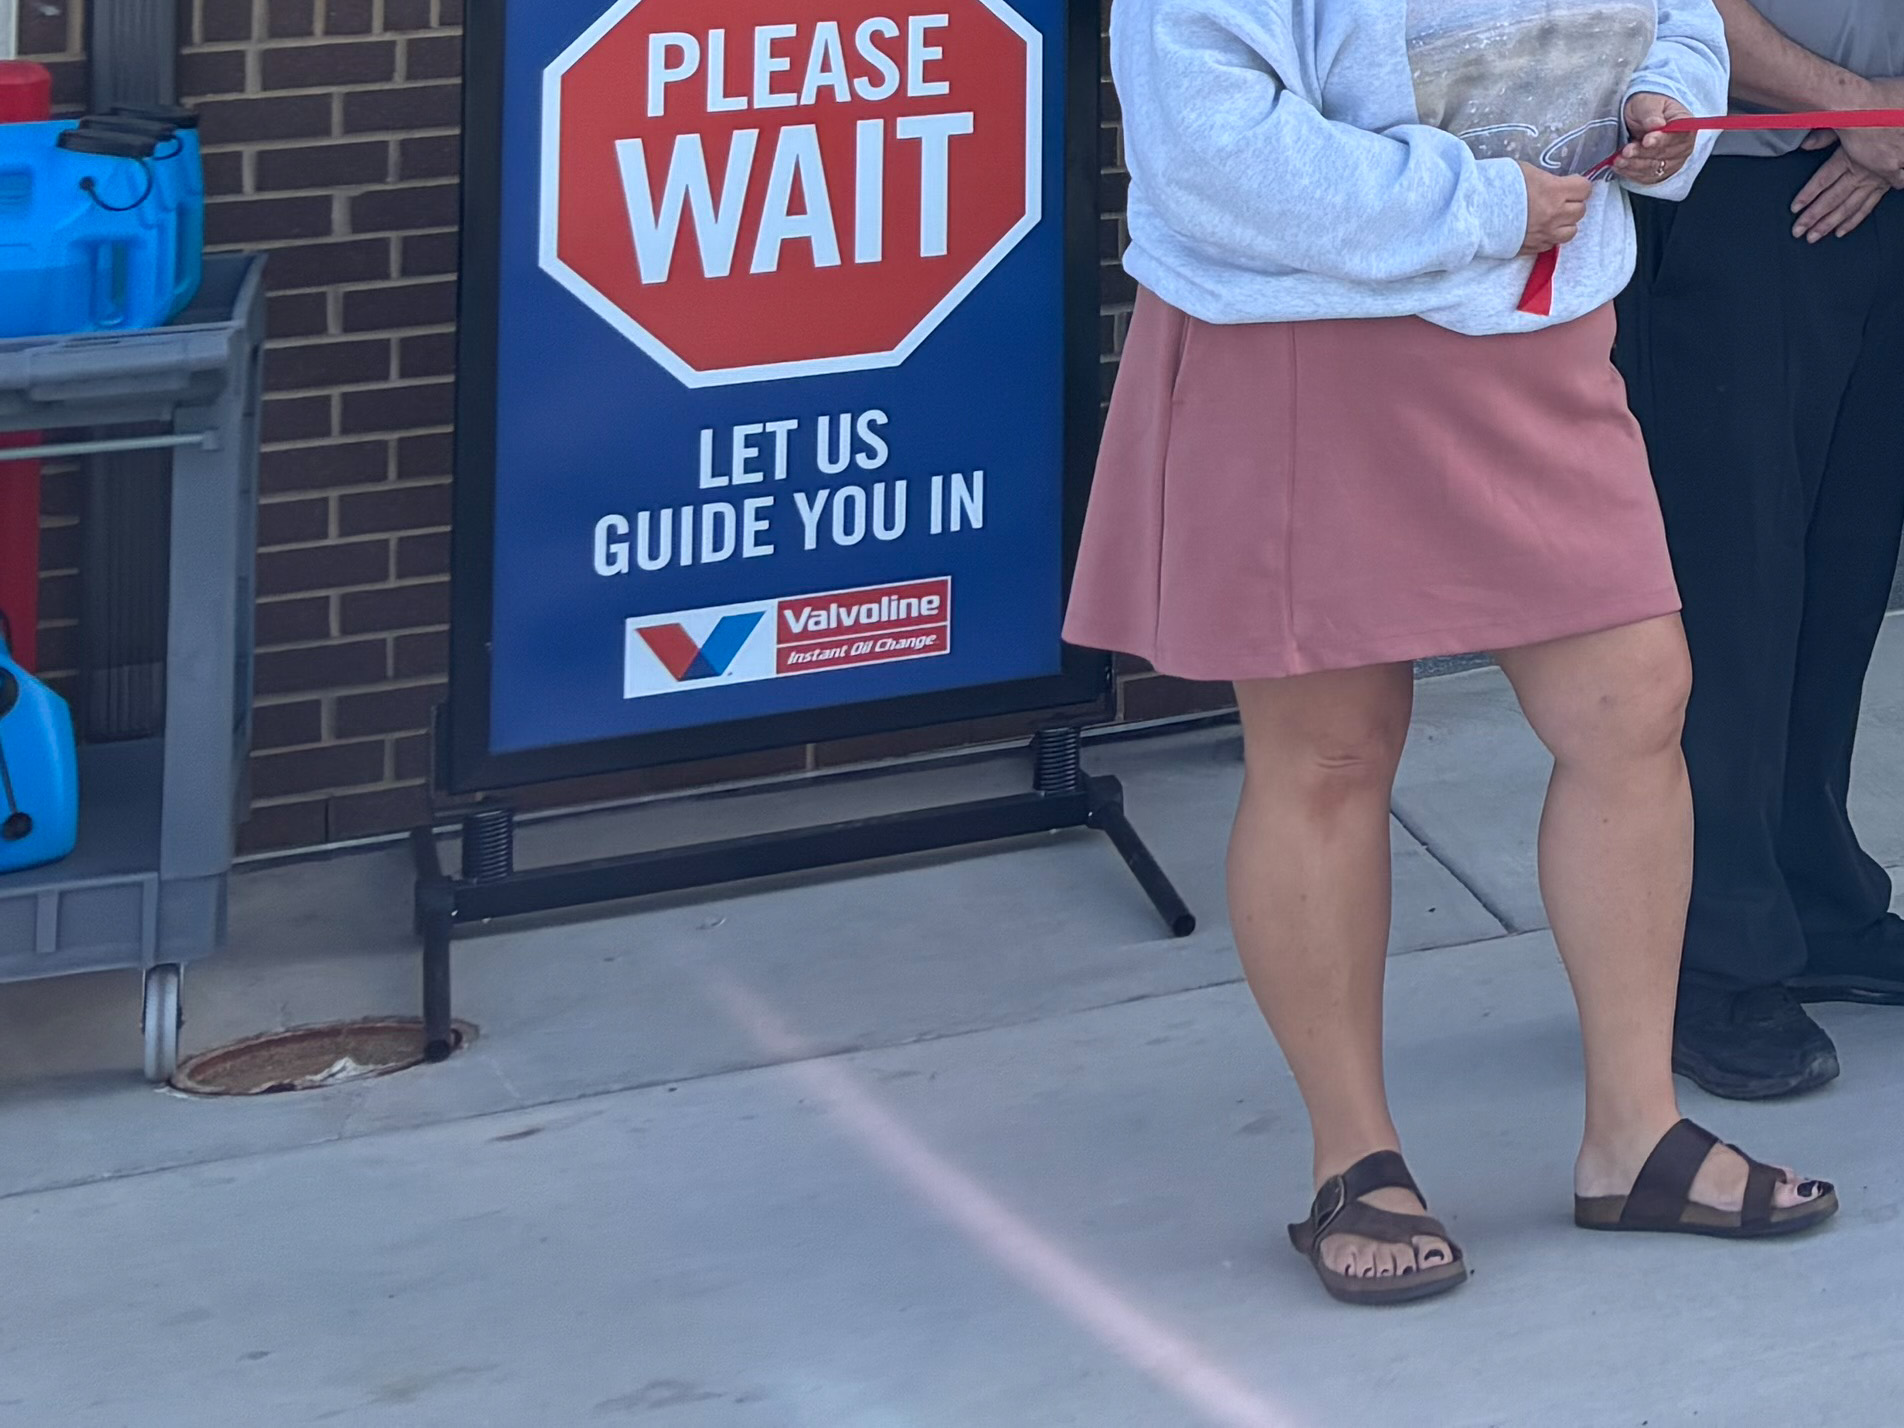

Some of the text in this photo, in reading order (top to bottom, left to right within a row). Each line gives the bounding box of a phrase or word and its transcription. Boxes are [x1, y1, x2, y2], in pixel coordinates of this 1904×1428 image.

[647, 13, 950, 117] PLEASE
[615, 111, 974, 284] WAIT
[700, 409, 889, 489] LET US
[594, 470, 984, 576] GUIDE YOU IN
[783, 595, 940, 633] Valvoline
[787, 634, 937, 665] Instant Oil Change
